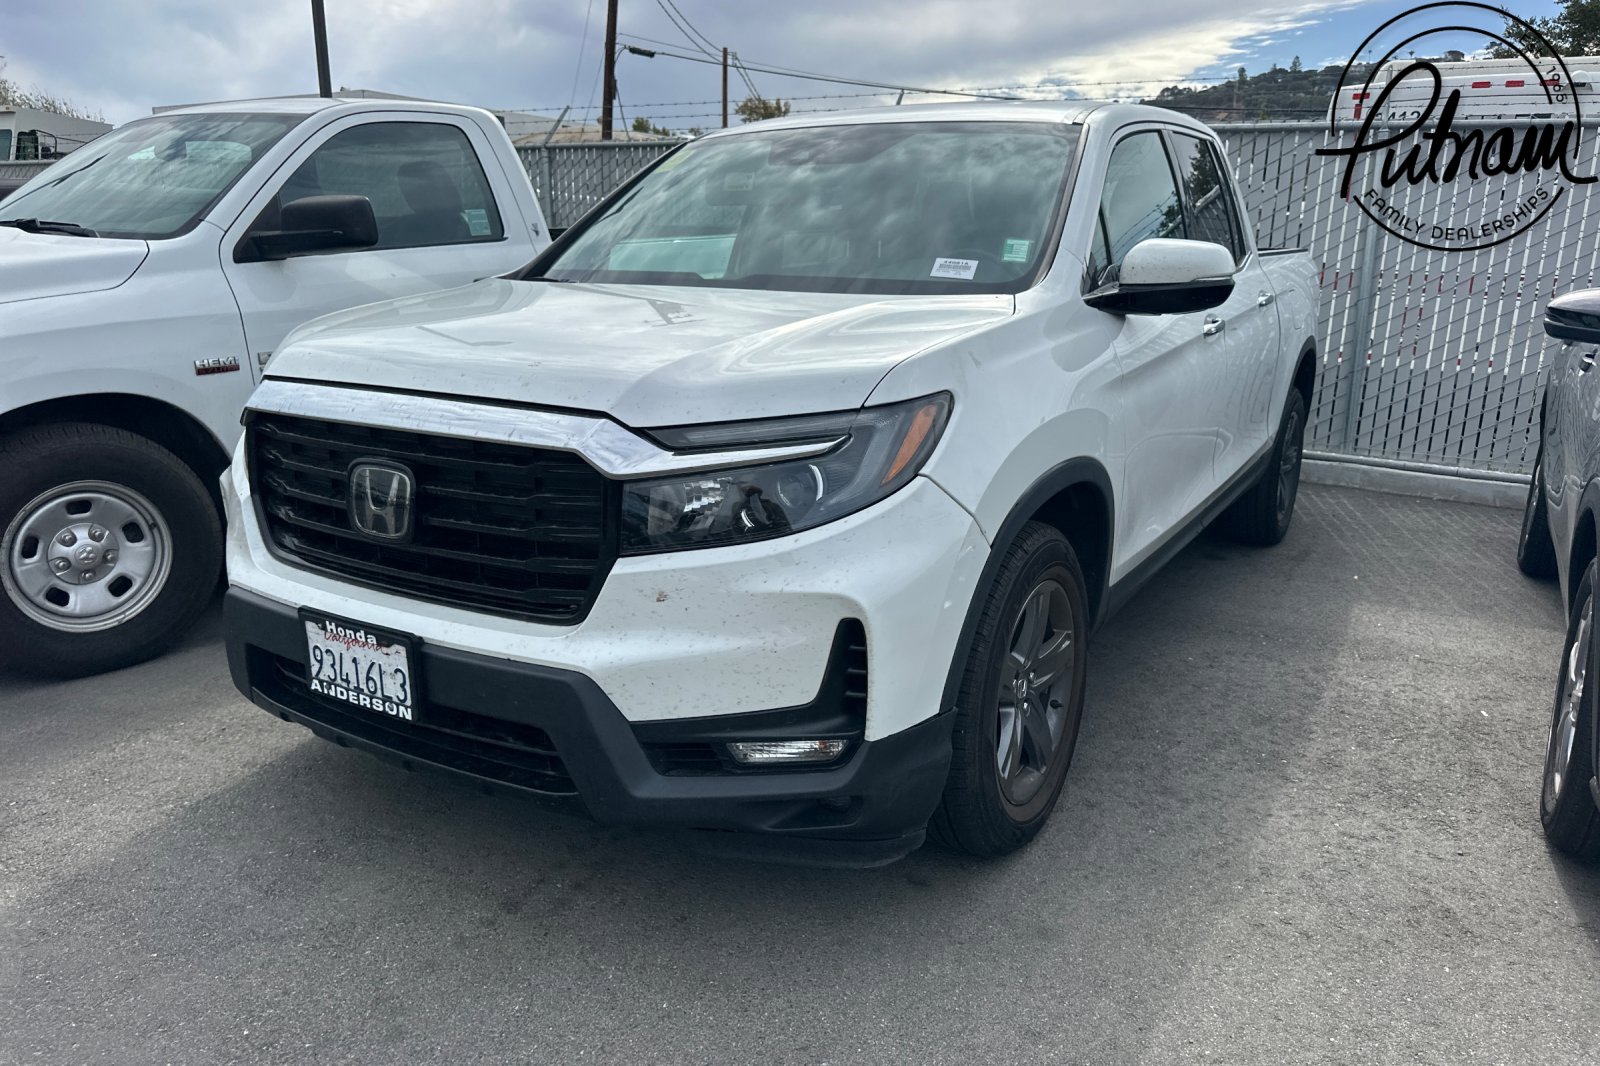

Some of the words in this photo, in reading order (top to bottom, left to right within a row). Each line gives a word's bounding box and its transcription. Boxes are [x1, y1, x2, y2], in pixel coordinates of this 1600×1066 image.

[194, 356, 239, 369] HEMI
[325, 620, 377, 644] Honda
[312, 645, 408, 704] 93416L3
[311, 679, 412, 720] ANDERSON
